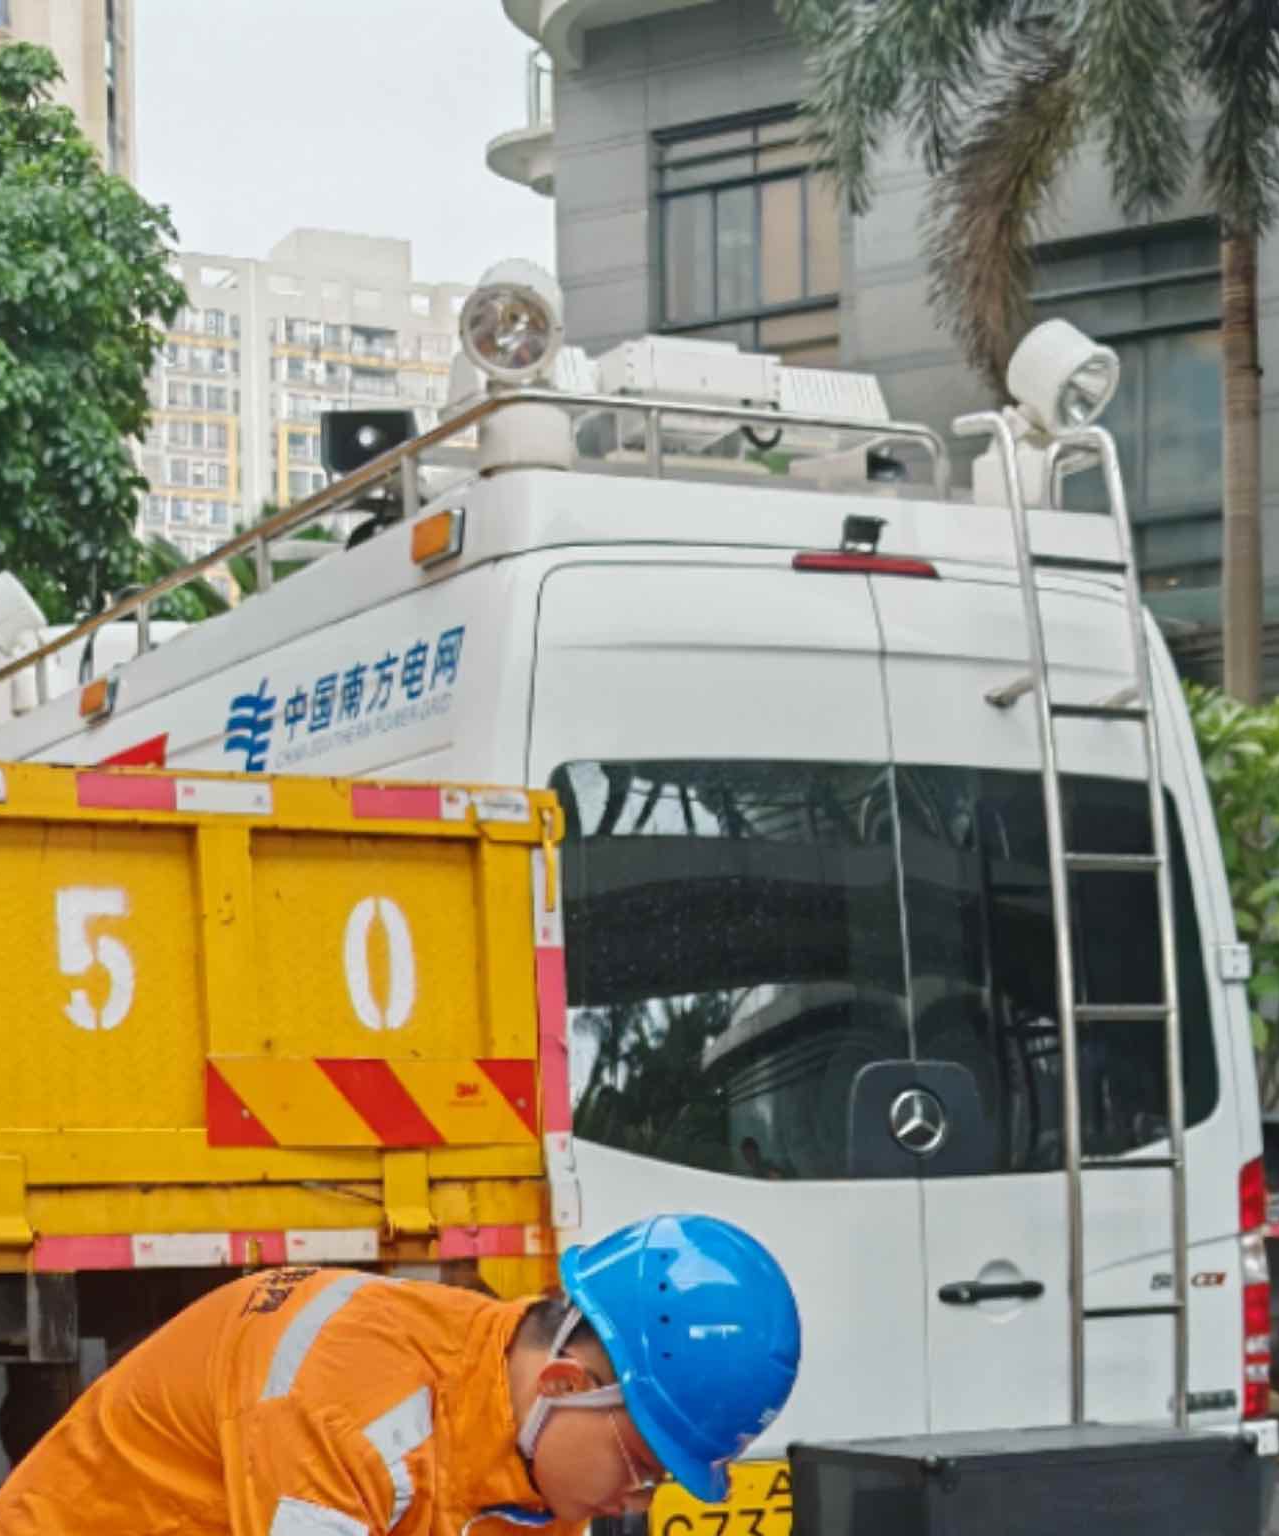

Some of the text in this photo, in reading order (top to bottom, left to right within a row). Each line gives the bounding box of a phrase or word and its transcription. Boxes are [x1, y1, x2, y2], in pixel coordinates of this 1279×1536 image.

[284, 625, 466, 742] 中国南方电网
